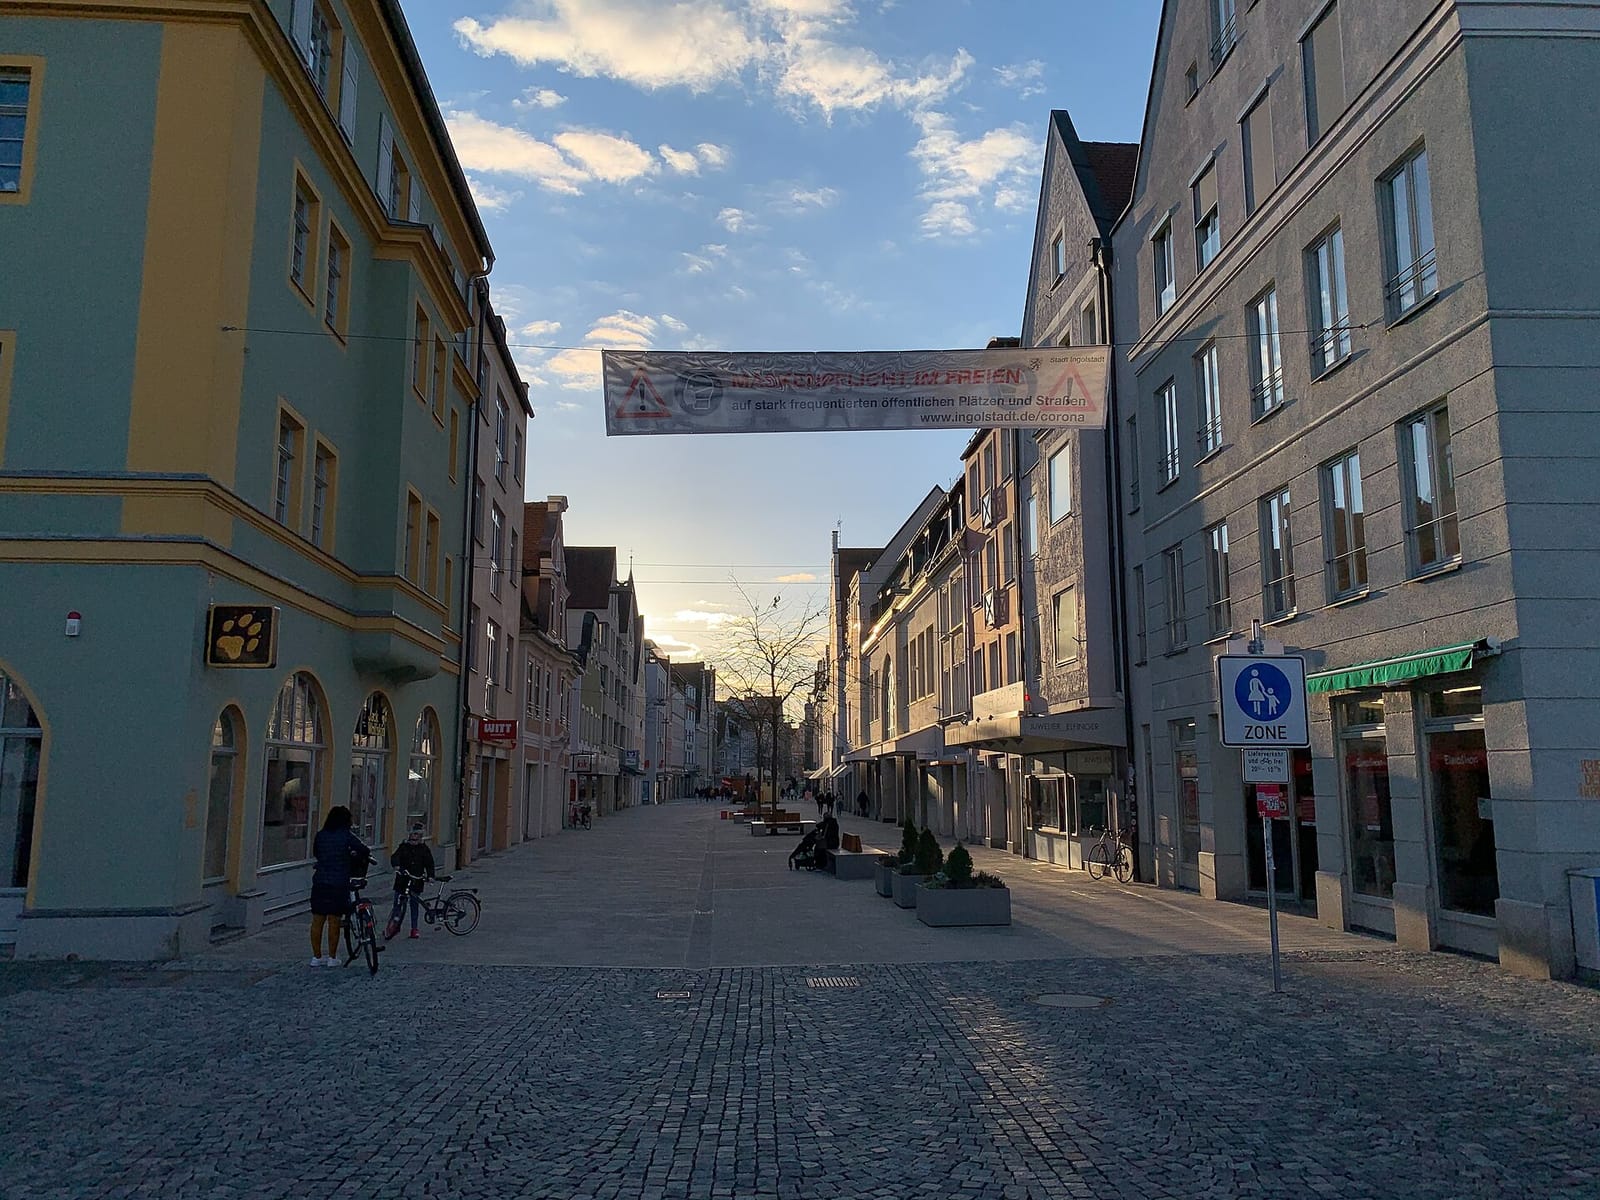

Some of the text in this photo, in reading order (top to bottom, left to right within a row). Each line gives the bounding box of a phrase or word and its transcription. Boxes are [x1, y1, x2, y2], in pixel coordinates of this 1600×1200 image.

[1069, 355, 1105, 364] Ingolstadt
[945, 368, 1020, 386] FREIEN
[731, 394, 1087, 412] auf stark frequentierten öffentlichen Plätzen und Straßen
[920, 411, 1086, 424] www.ingolstadt.de/corona
[484, 723, 512, 733] WITT
[1244, 725, 1288, 740] ZONE
